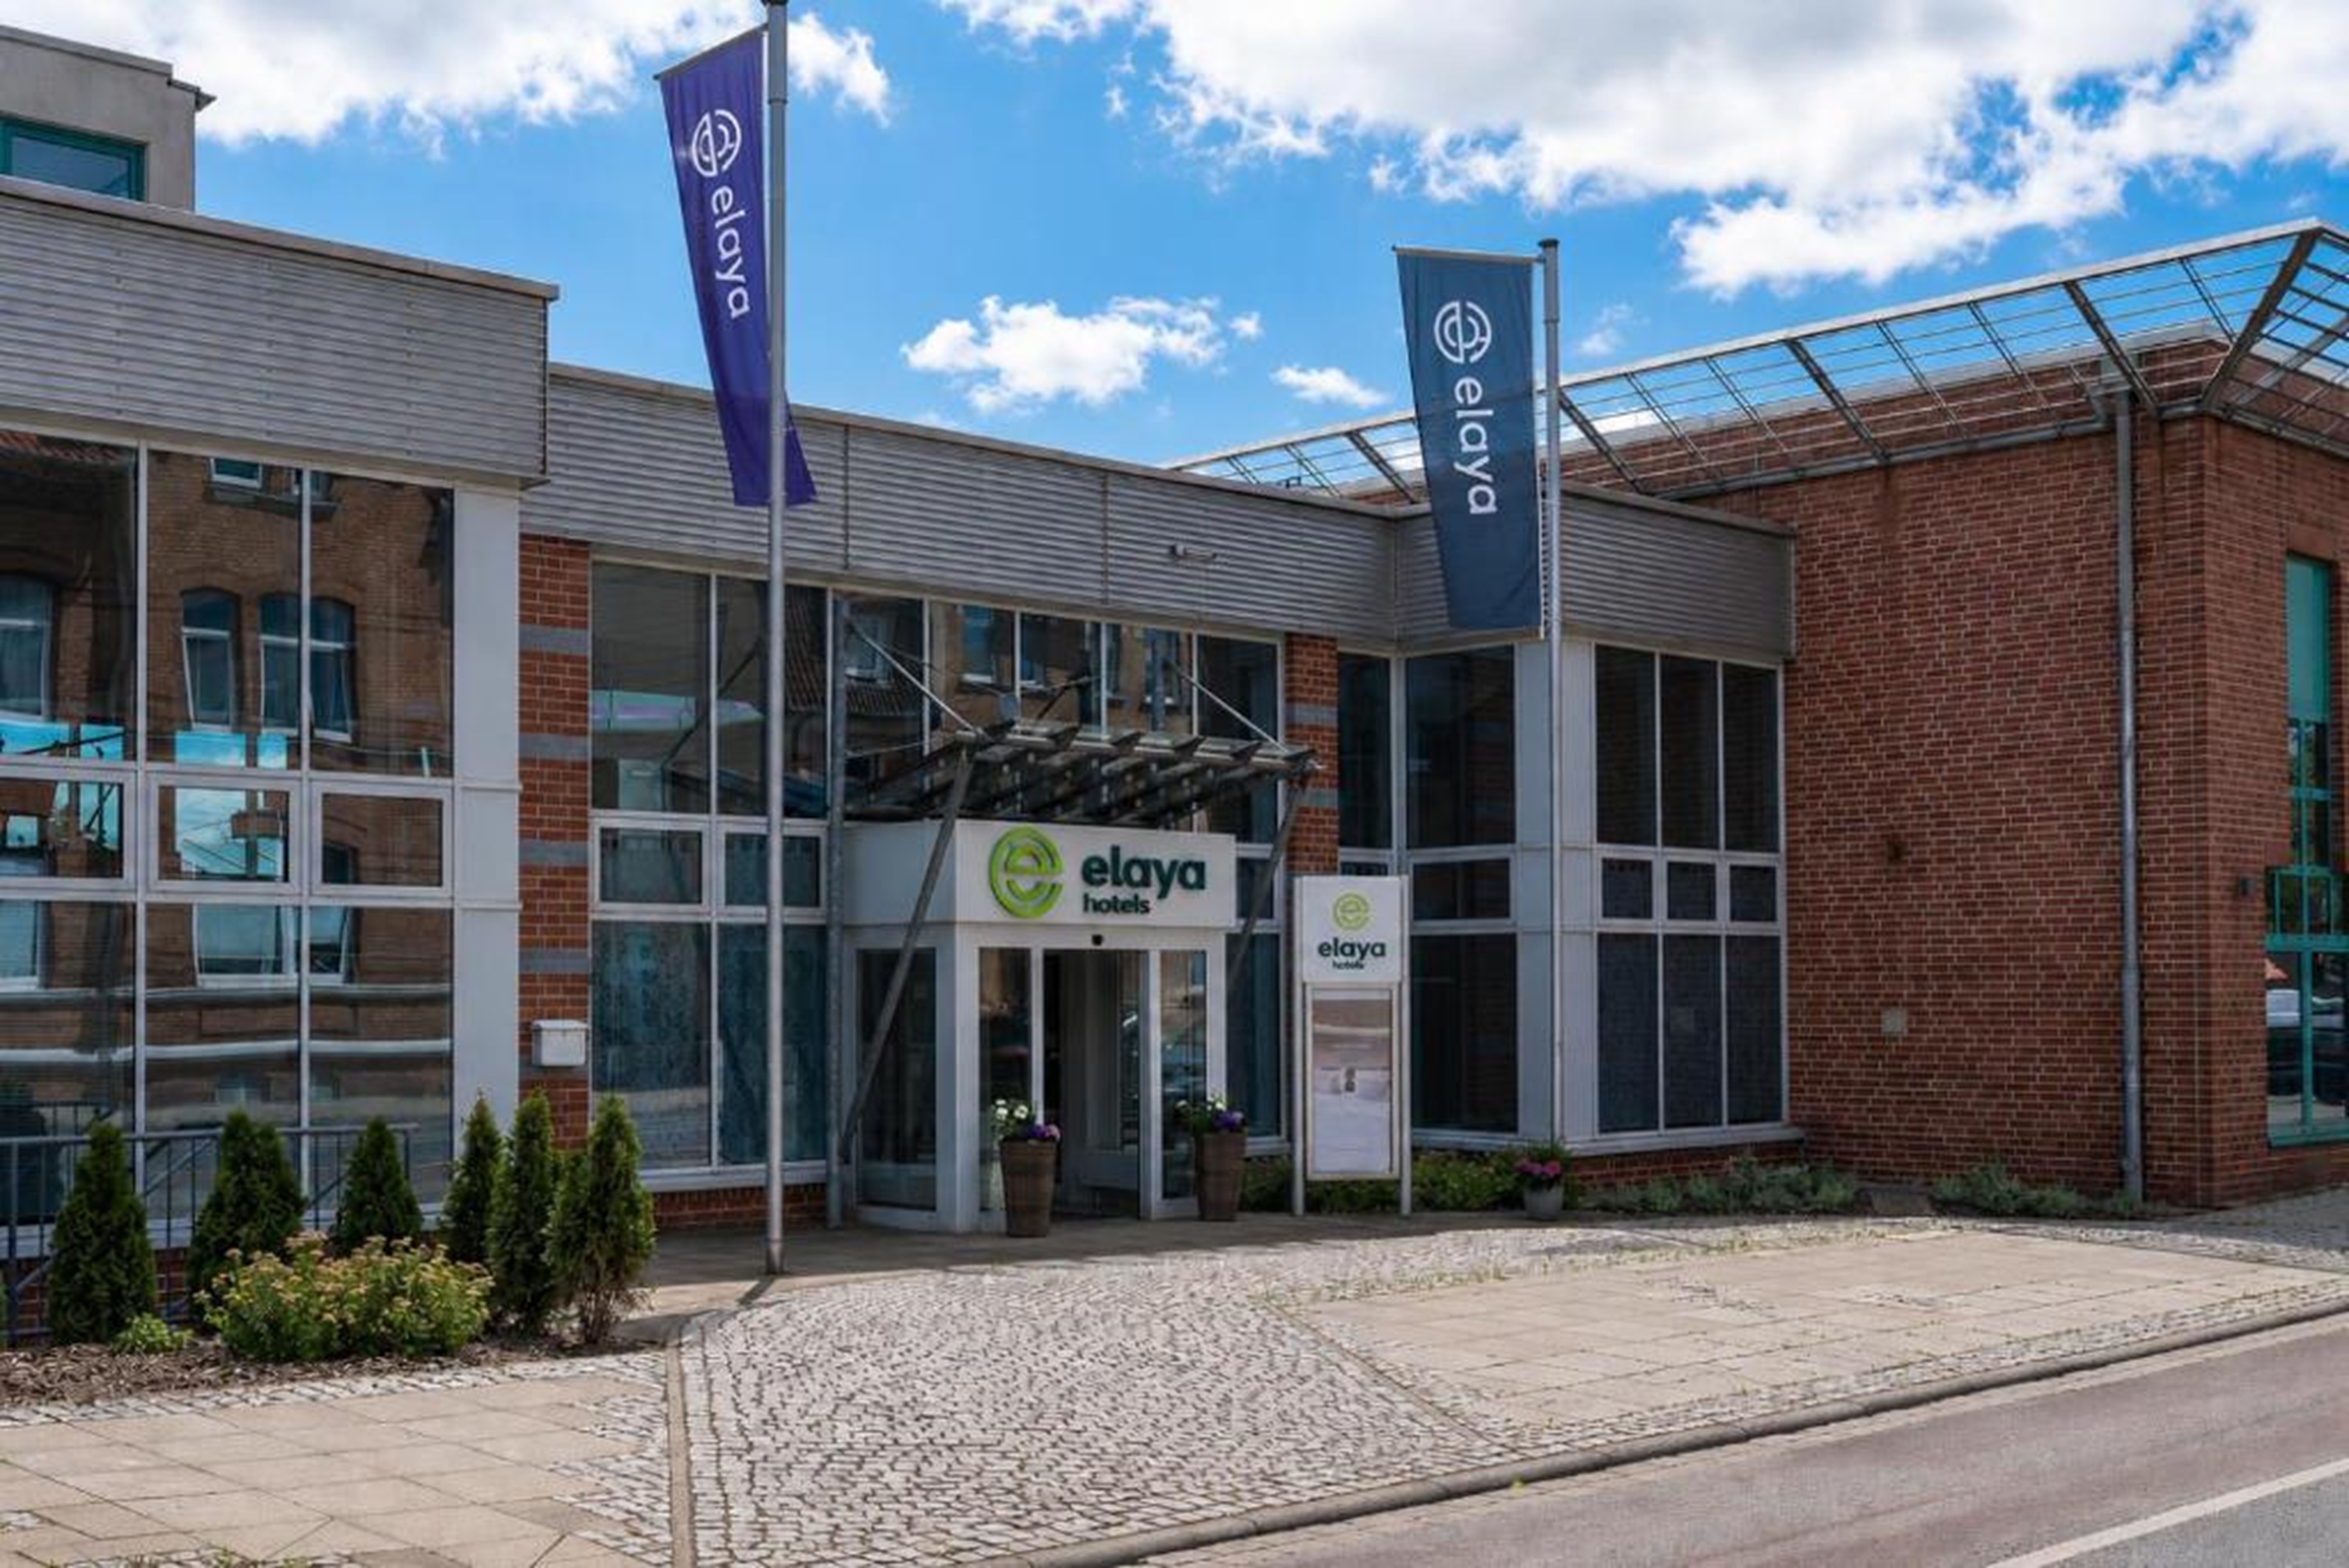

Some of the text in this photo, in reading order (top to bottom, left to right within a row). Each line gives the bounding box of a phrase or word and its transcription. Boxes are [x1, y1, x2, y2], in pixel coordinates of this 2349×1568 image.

[711, 186, 750, 319] elaya
[1454, 377, 1497, 515] elaya
[1081, 845, 1207, 899] elaya
[1082, 893, 1151, 914] hotels
[1317, 937, 1386, 961] elaya
